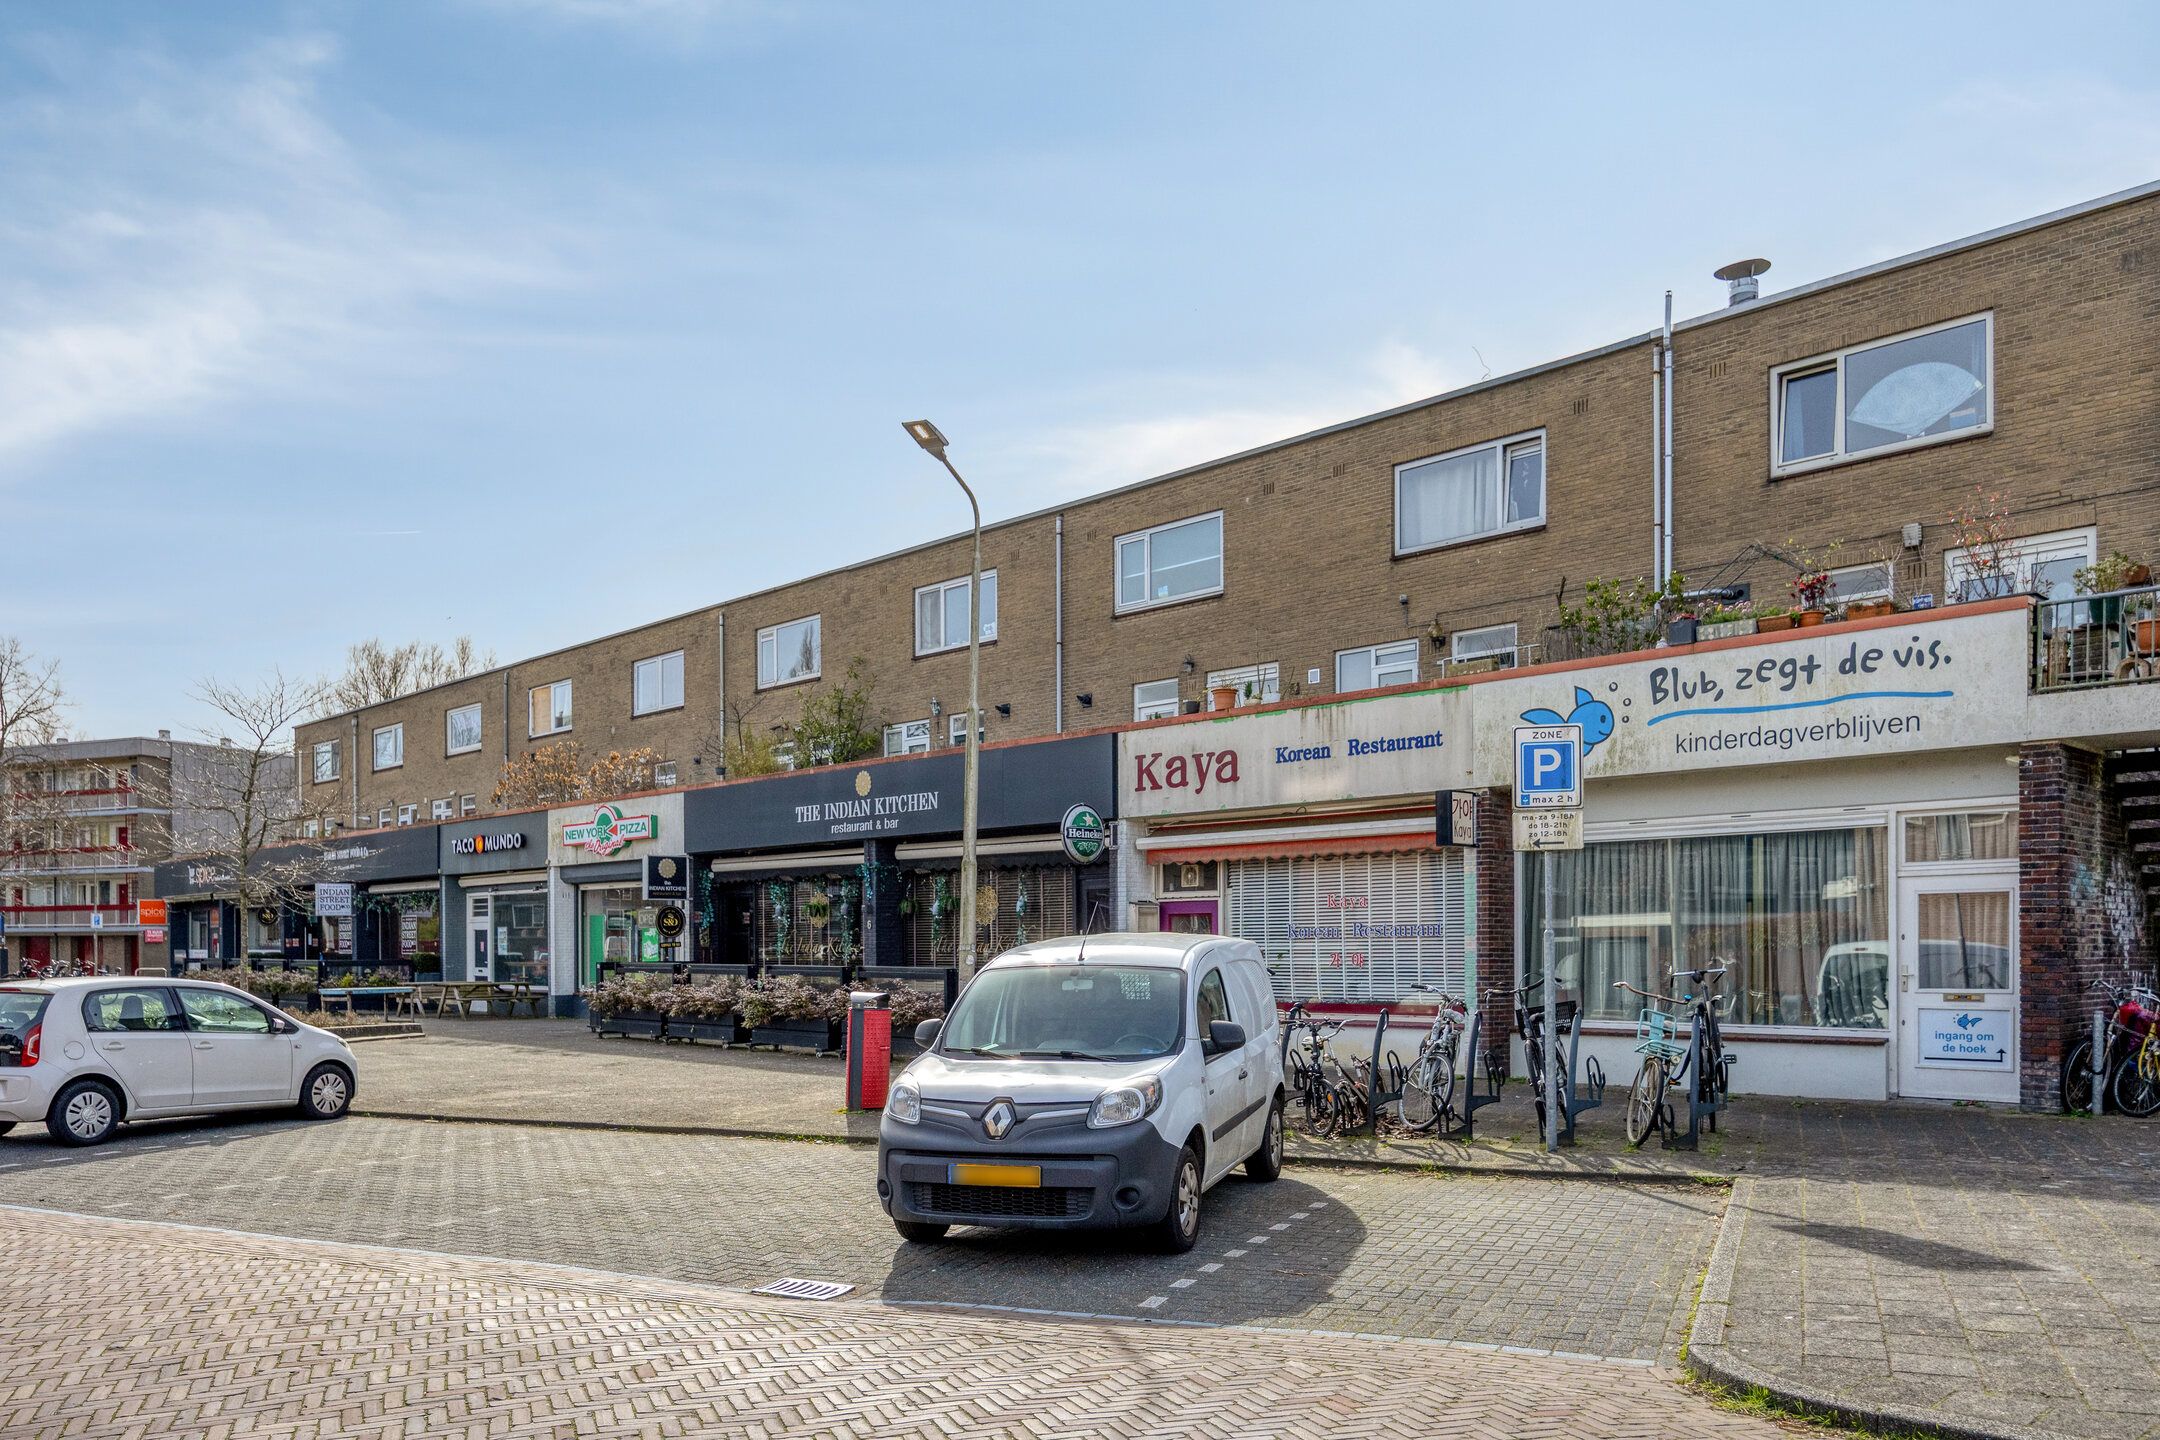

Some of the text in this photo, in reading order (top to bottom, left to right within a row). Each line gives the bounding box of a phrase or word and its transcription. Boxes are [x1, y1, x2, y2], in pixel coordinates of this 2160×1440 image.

[1650, 635, 1952, 706] Blub, zegt de vis.
[1532, 730, 1563, 740] ZONE
[1676, 712, 1922, 754] kinderdagverblijven
[1134, 730, 1444, 795] Kaya Korean Restaurant
[1533, 748, 1561, 786] P
[795, 791, 939, 824] THE INDIAN KITCHEN
[1557, 794, 1564, 803] 2
[1567, 794, 1573, 803] h
[565, 821, 647, 841] NEW YORK PIZZA
[831, 816, 899, 834] restaurant & bar
[1453, 820, 1472, 840] Kaya
[451, 832, 522, 854] TACO MUNDO
[1326, 893, 1368, 910] Kaya
[140, 908, 165, 917] spice
[866, 920, 872, 930] 6
[1287, 921, 1443, 939] Korean Restaurant
[1934, 1030, 1995, 1043] ingang om
[1942, 1043, 1987, 1053] de hoek
